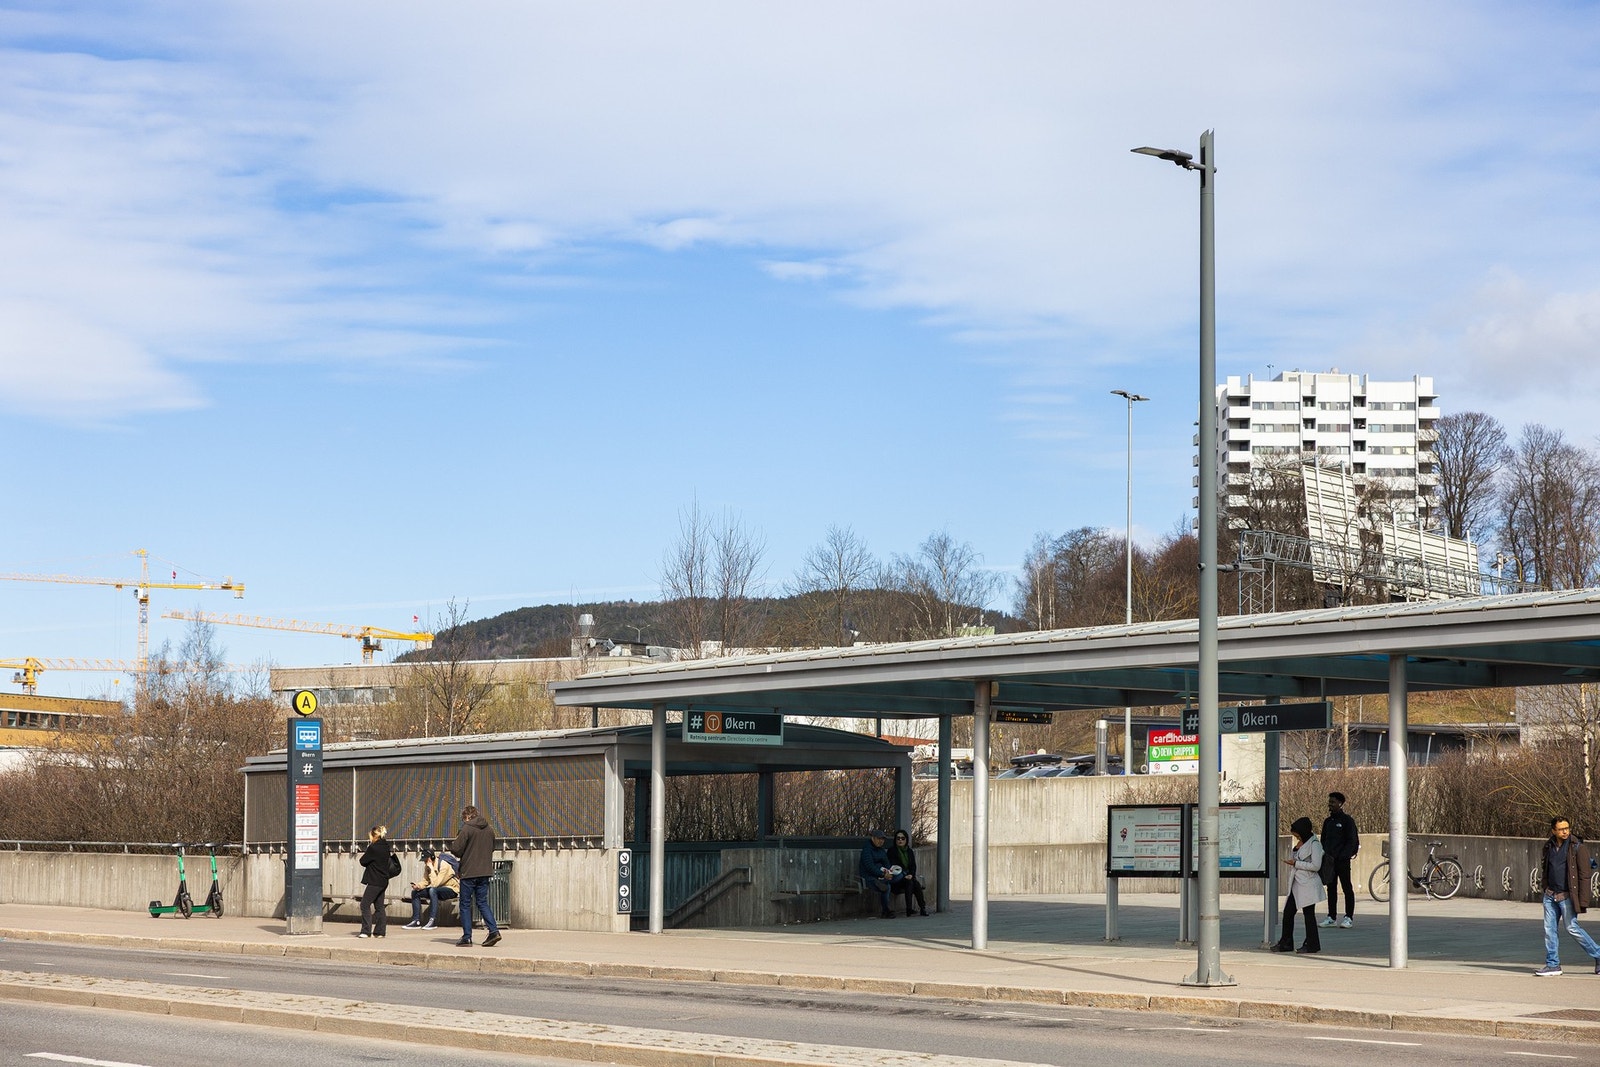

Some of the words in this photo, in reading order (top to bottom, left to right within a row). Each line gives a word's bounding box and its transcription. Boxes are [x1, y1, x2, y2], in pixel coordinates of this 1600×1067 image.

[302, 696, 311, 708] A
[725, 717, 756, 730] Økern
[1242, 712, 1278, 727] Økern
[1173, 746, 1195, 756] GRUPPEN
